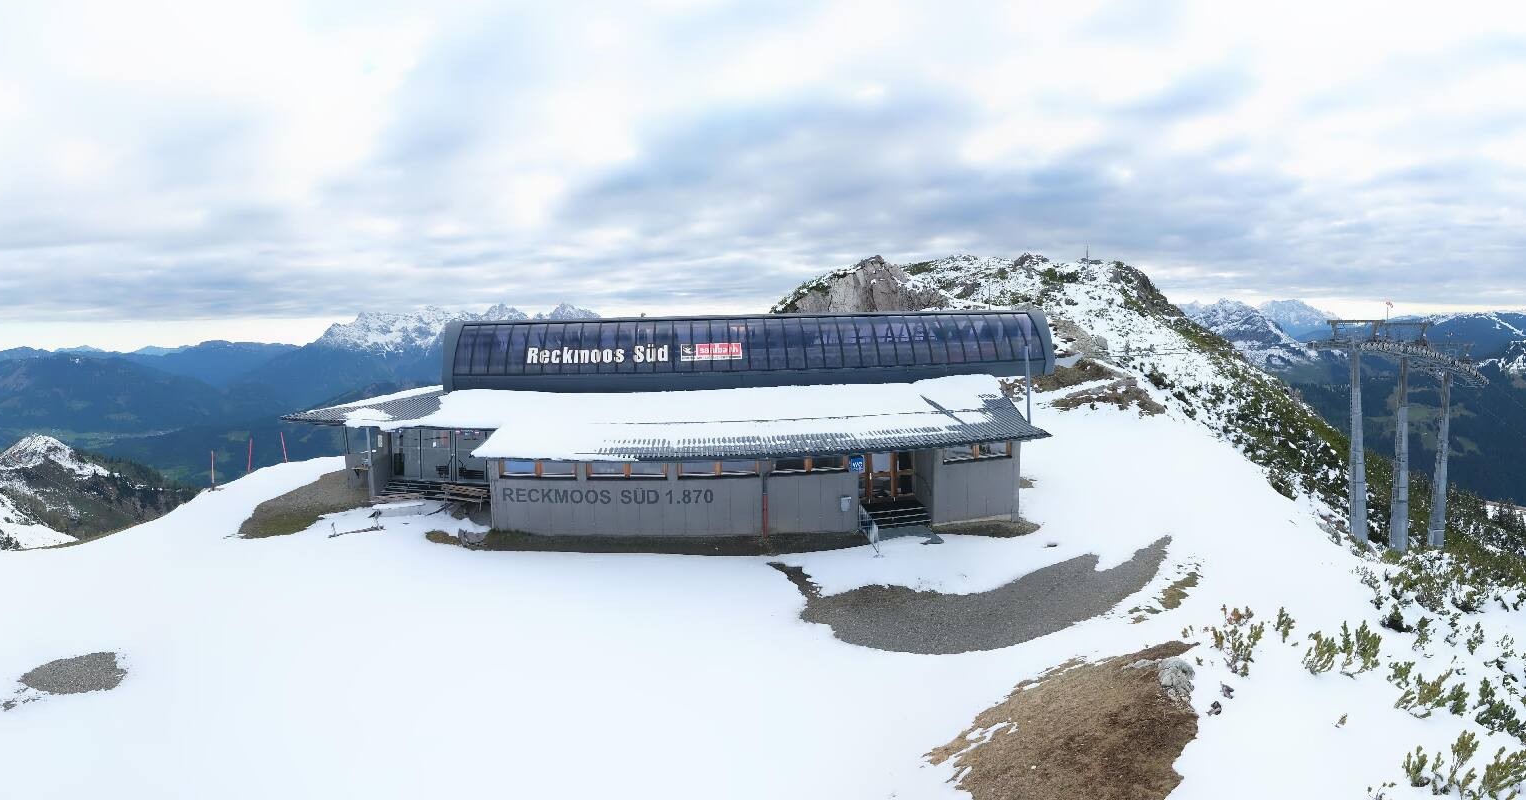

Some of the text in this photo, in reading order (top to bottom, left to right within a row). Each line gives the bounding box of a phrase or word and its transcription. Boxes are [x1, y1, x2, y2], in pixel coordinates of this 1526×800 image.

[526, 344, 669, 364] Reckmoos Süd
[502, 487, 714, 504] RECKMOOS SÜD 1.870
